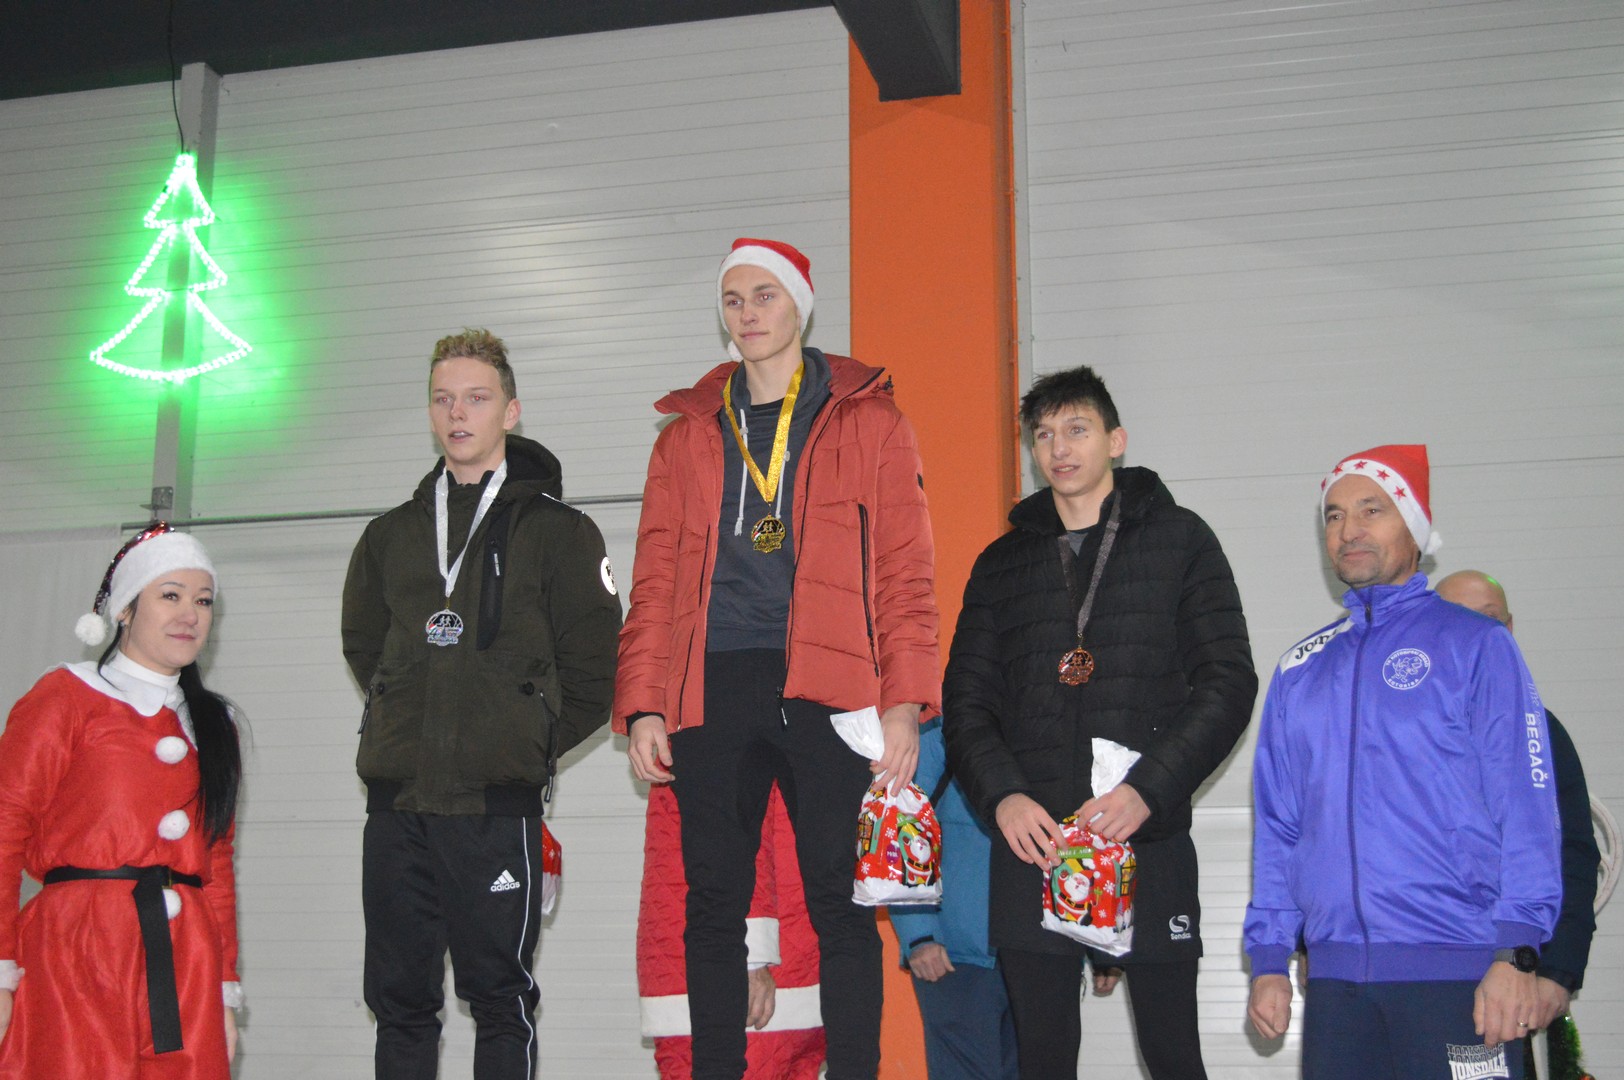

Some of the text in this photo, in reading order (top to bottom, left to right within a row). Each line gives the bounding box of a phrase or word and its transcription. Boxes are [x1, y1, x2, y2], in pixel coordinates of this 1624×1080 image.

[1294, 629, 1337, 660] Jom
[1525, 713, 1548, 788] BEGAČI
[490, 882, 520, 892] adidas
